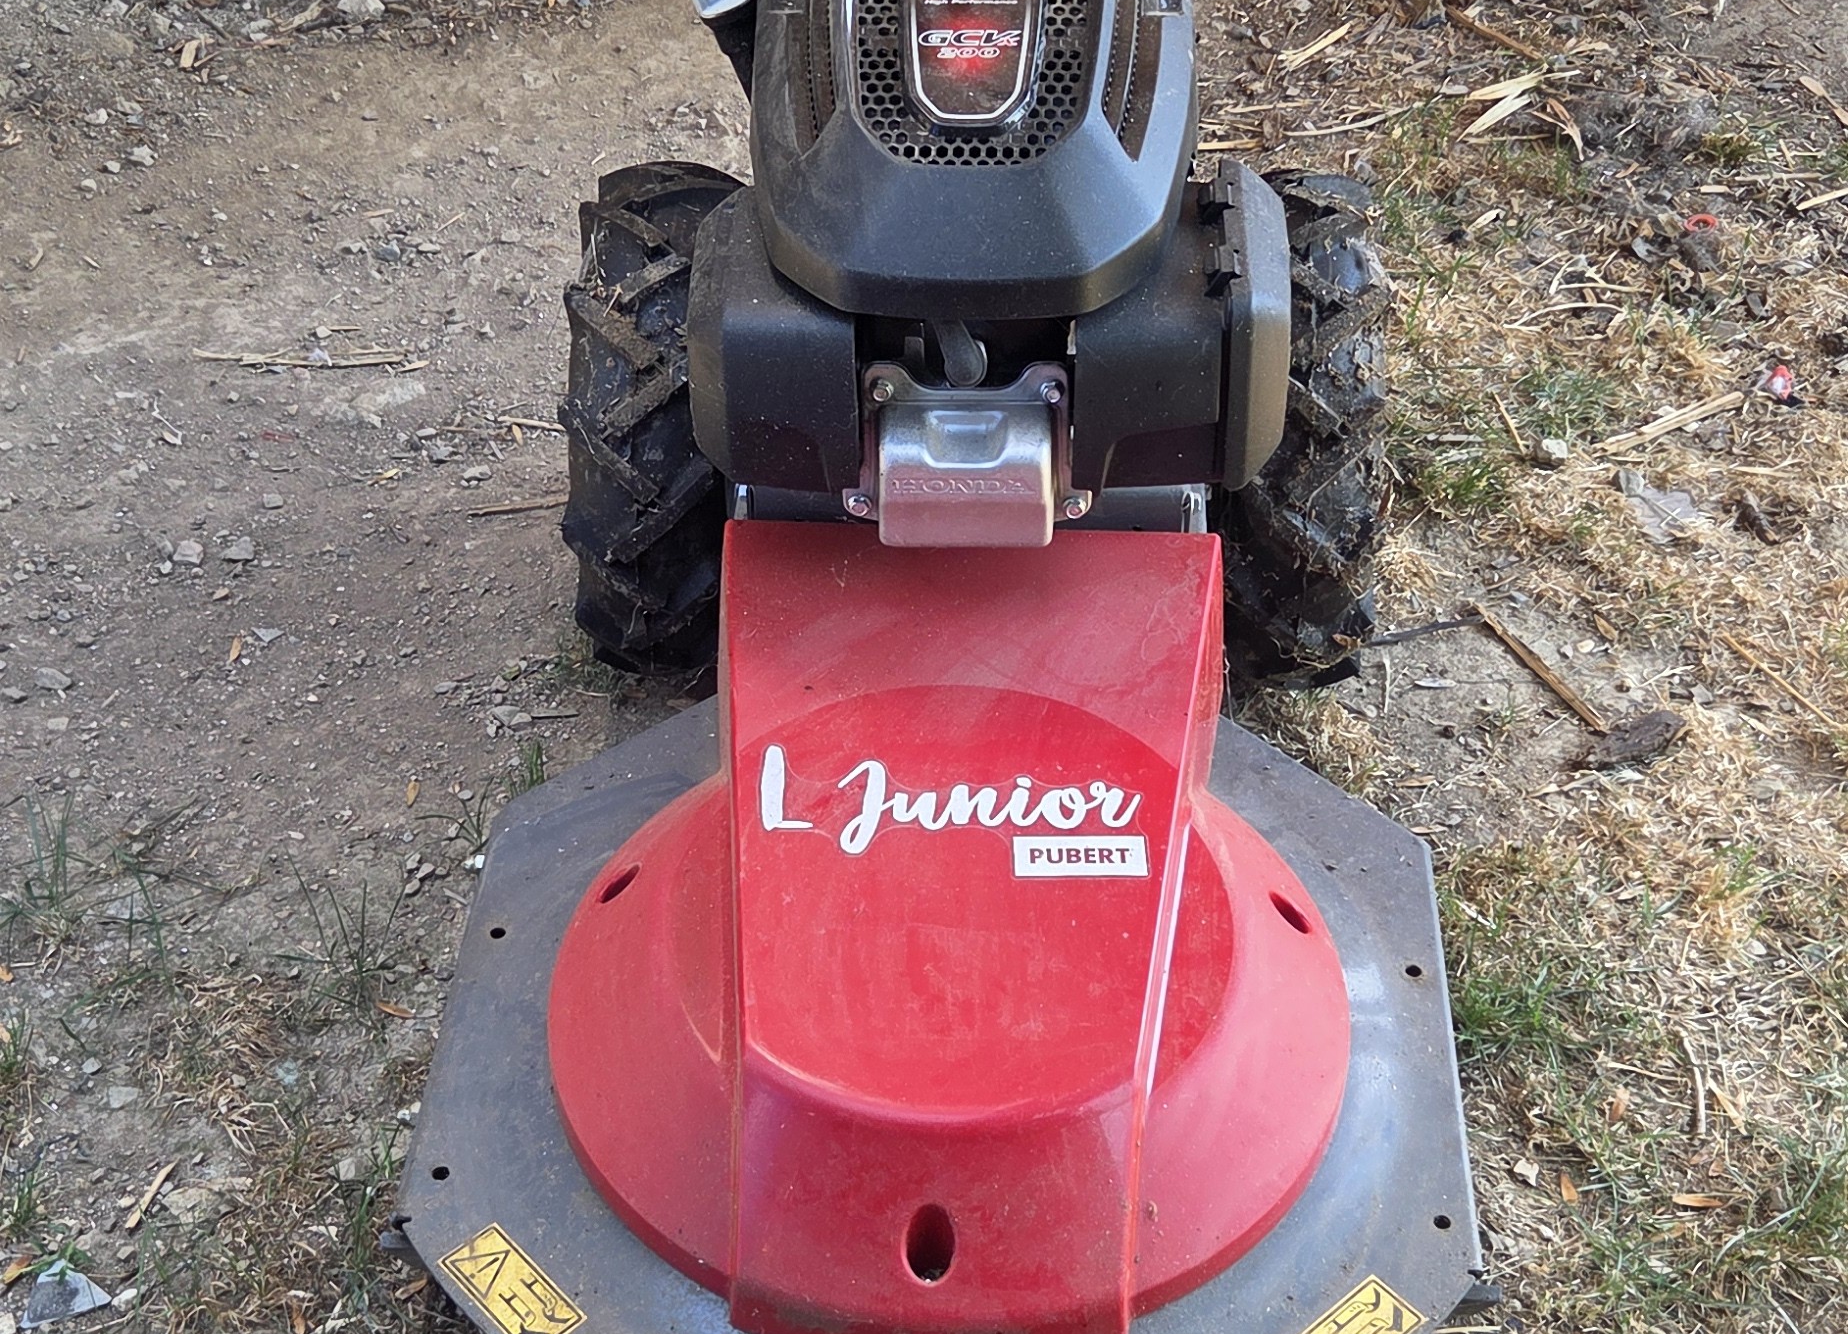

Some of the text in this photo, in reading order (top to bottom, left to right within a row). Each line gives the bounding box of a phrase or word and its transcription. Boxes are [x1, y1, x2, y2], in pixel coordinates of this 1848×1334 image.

[937, 47, 1000, 59] 200
[894, 478, 1034, 495] HONDA
[760, 744, 1142, 856] L Junior
[1029, 847, 1131, 865] PUBERT
